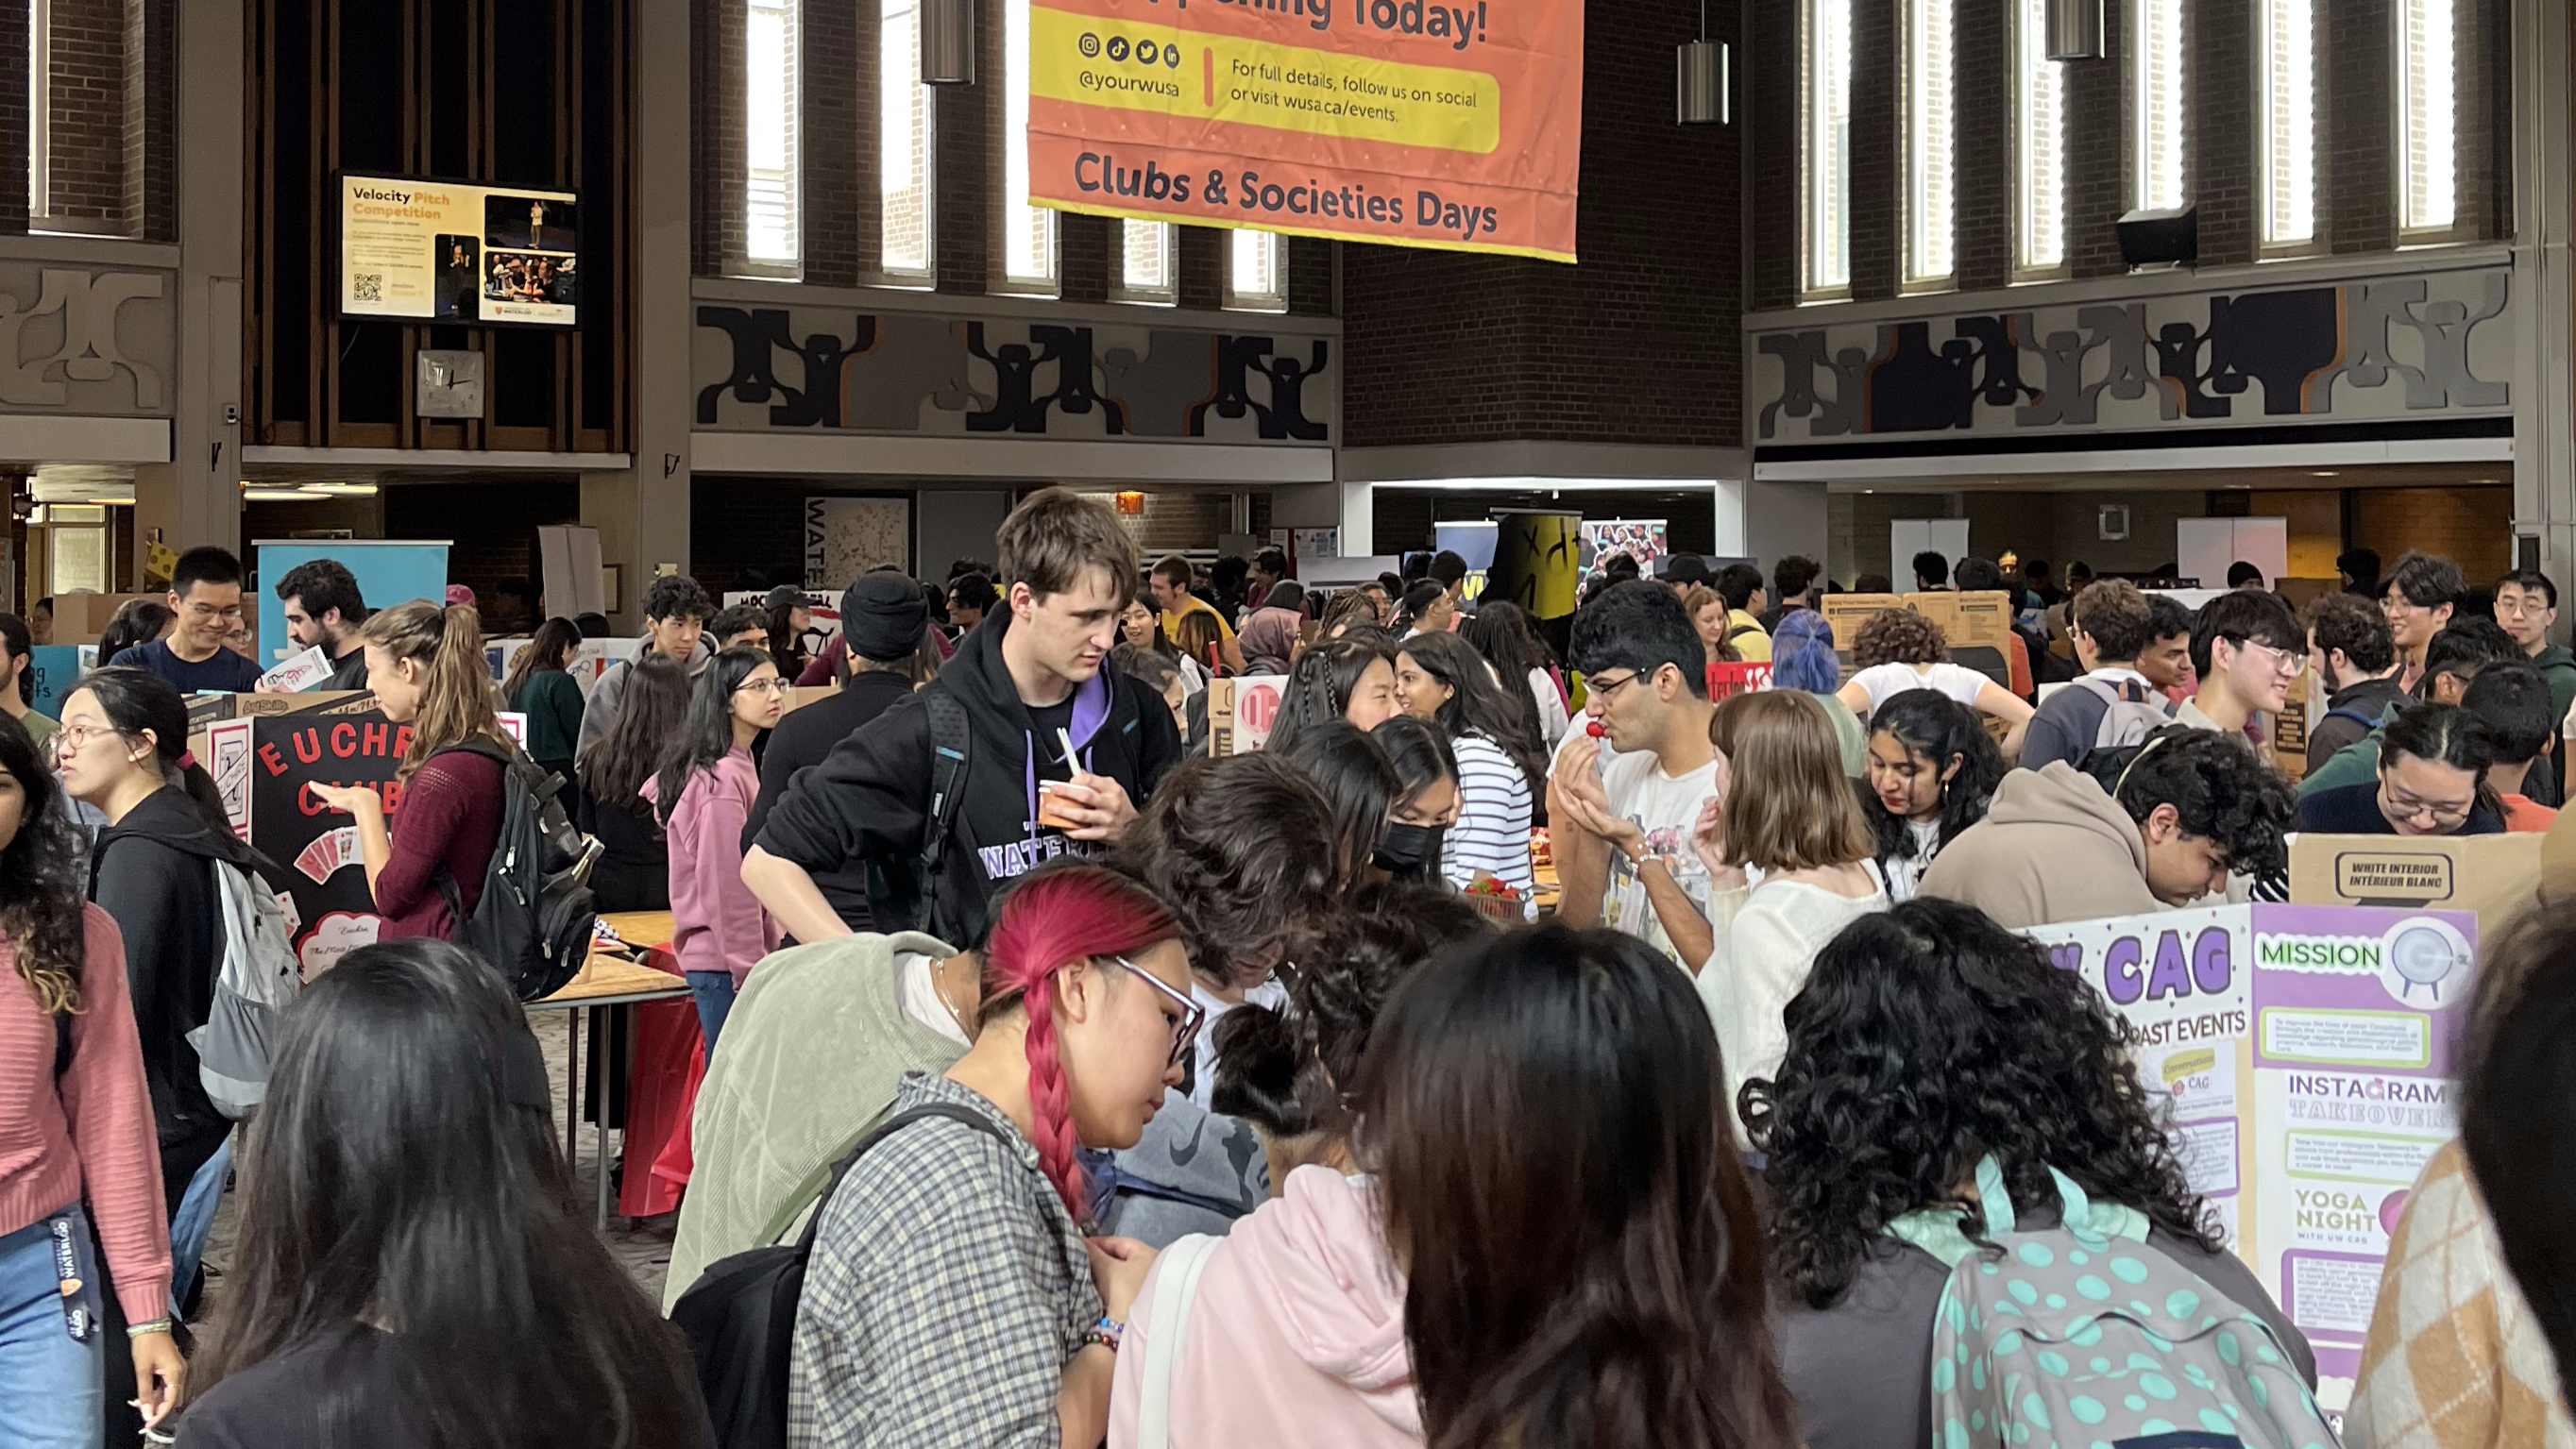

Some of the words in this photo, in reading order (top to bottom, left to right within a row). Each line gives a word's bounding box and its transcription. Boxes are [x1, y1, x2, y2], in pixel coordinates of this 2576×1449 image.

[1079, 71, 1179, 97] @yourwusa
[1232, 59, 1256, 77] For
[1260, 63, 1281, 82] full
[1286, 68, 1337, 92] details,
[1343, 75, 1388, 95] follow
[1392, 87, 1407, 99] us
[1411, 90, 1432, 102] on
[1435, 90, 1477, 108] social
[1230, 88, 1248, 101] or
[1251, 88, 1279, 107] visit
[353, 187, 411, 205] Velocity
[414, 192, 449, 206] Pitch
[1074, 151, 1191, 203] Clubs
[1202, 169, 1229, 206] &
[1239, 170, 1404, 224] Societies
[1416, 190, 1498, 241] Days
[353, 202, 441, 220] Competition
[807, 499, 826, 592] WATE
[740, 595, 767, 607] MOC
[243, 699, 289, 715] ArtSkills
[257, 722, 416, 777] EUCHR
[2351, 863, 2387, 873] WHITE
[2389, 864, 2439, 874] INTERIOR
[2349, 875, 2404, 886] INTÉRIEUR
[2406, 877, 2442, 888] BLANC
[2104, 926, 2232, 1006] CAG
[2262, 942, 2381, 968] MISSION
[2178, 1010, 2246, 1041] EVENTS
[2188, 1076, 2210, 1089] CAG
[2296, 1188, 2368, 1212] YOGA
[2296, 1209, 2377, 1233] NIGHT
[59, 1222, 76, 1278] WATERLOO
[2297, 1232, 2323, 1241] WITH
[2328, 1234, 2344, 1242] UW
[2348, 1236, 2368, 1245] CAG
